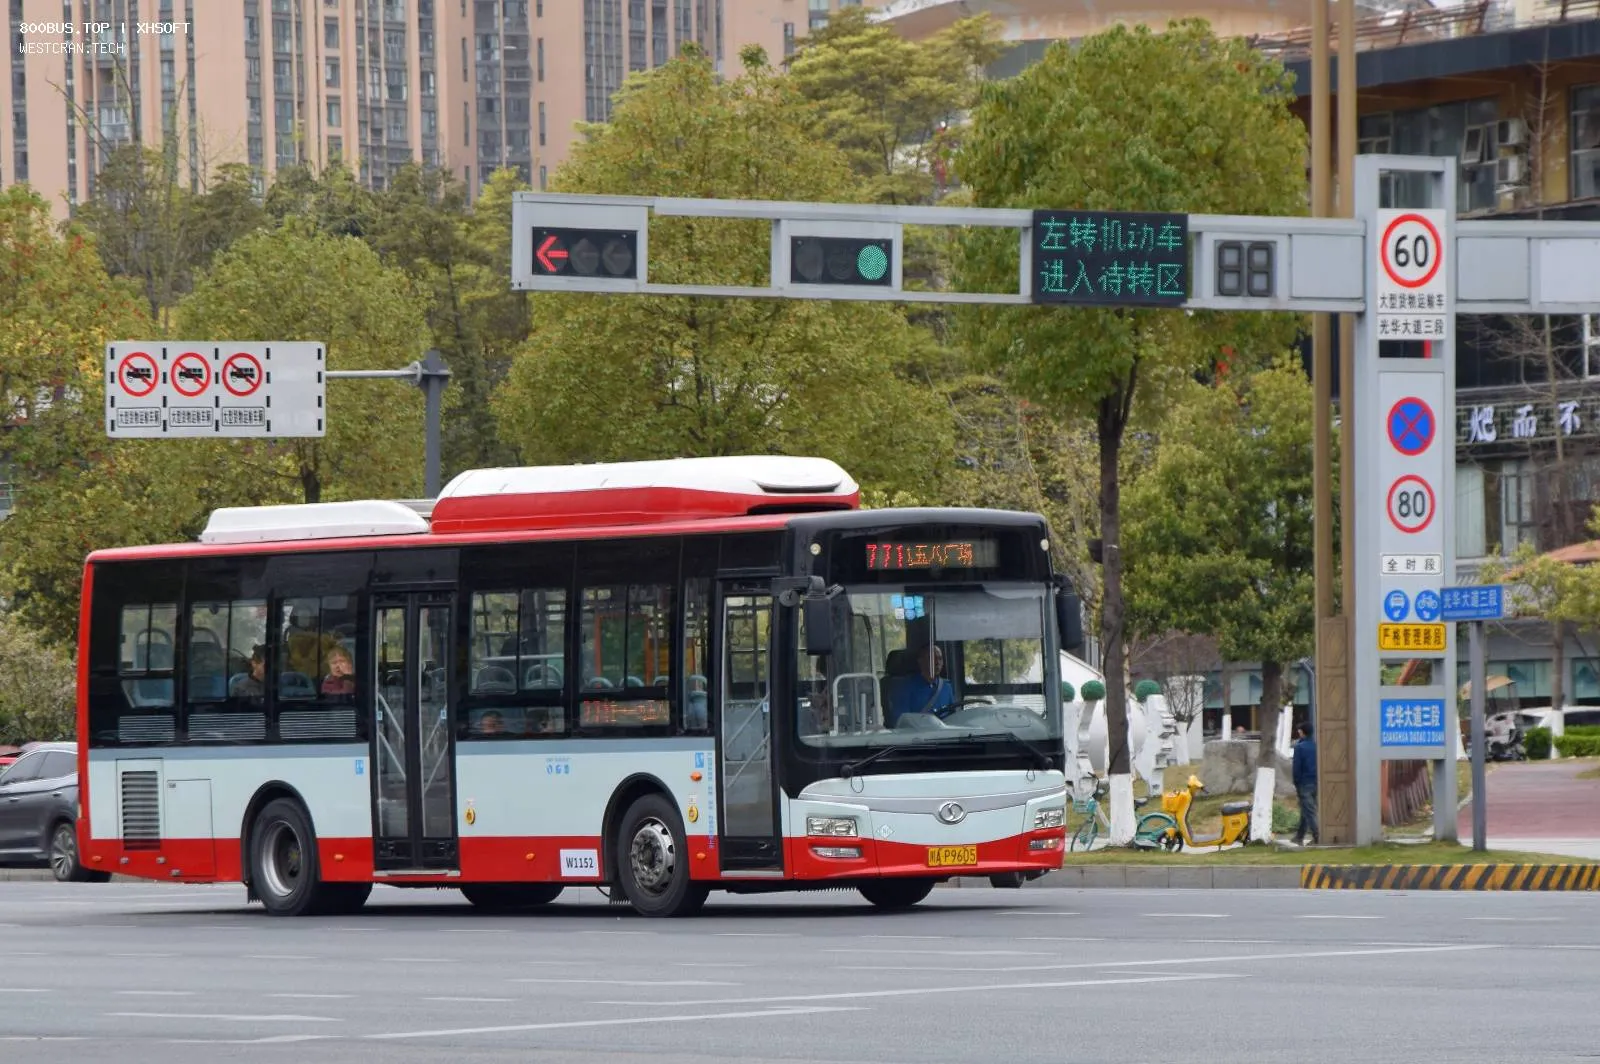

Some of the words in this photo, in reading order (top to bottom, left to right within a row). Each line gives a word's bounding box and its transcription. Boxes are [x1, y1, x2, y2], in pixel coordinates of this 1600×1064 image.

[1040, 215, 1183, 252] 左转机动车
[1394, 234, 1429, 268] 60
[1040, 259, 1185, 296] 进入待转区
[1379, 318, 1445, 335] 光华大道三段
[1398, 490, 1426, 518] 80
[866, 544, 904, 568] 771
[1387, 558, 1436, 572] 全时段
[1443, 589, 1498, 609] 光华大道三段
[1385, 704, 1441, 728] 光华大道三段
[565, 857, 594, 869] W1152
